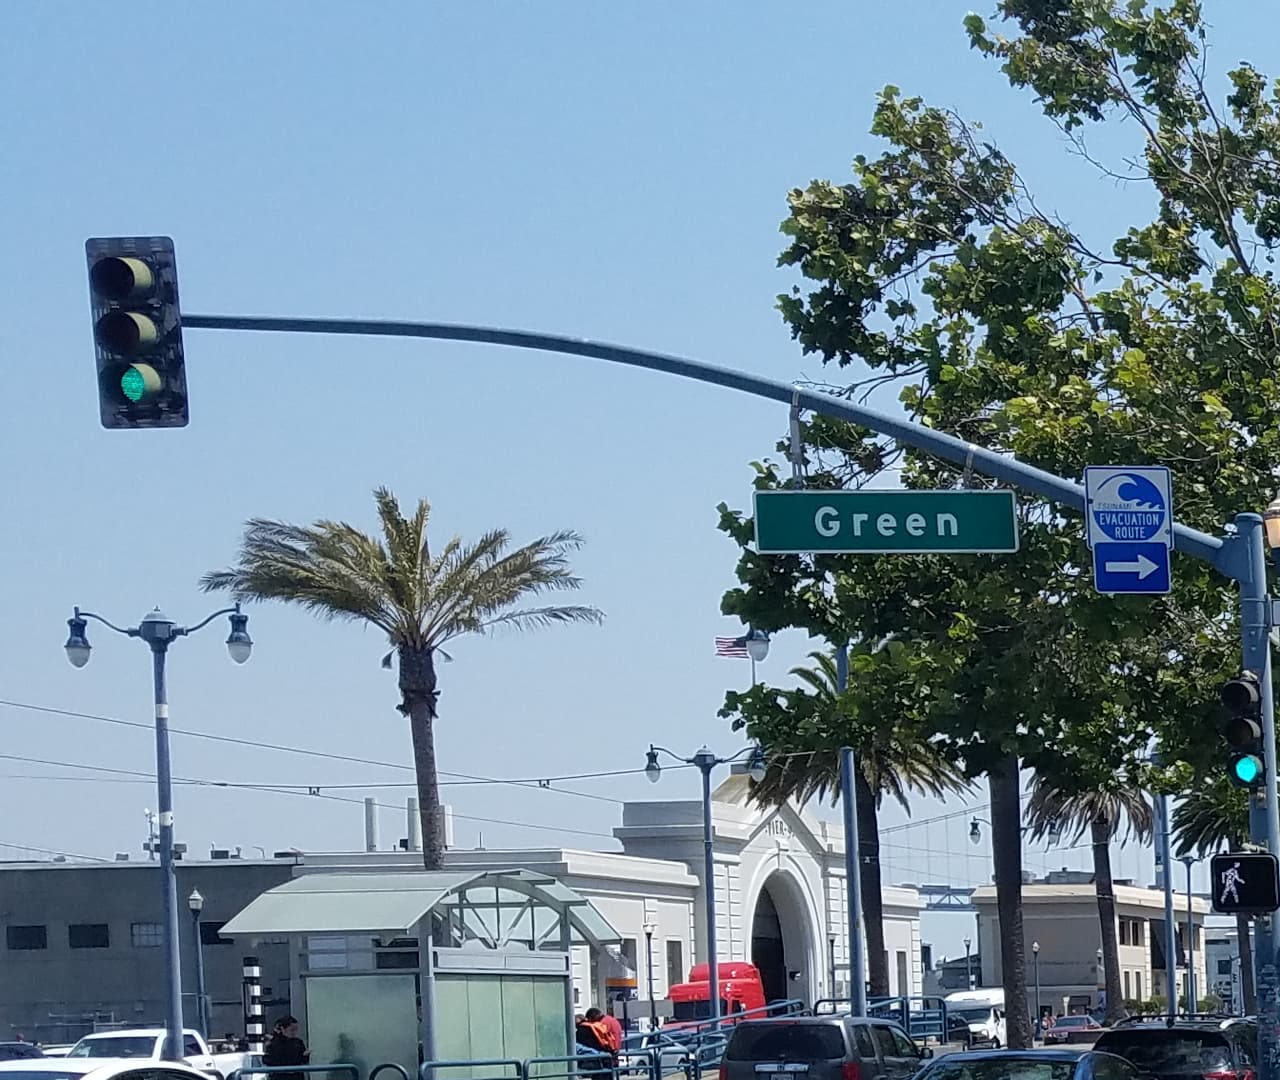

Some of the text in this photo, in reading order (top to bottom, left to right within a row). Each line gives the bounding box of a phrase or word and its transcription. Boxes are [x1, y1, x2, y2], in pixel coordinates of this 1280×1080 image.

[814, 506, 959, 537] Green
[1099, 512, 1160, 526] EVACUATION
[1114, 526, 1146, 539] ROUTE
